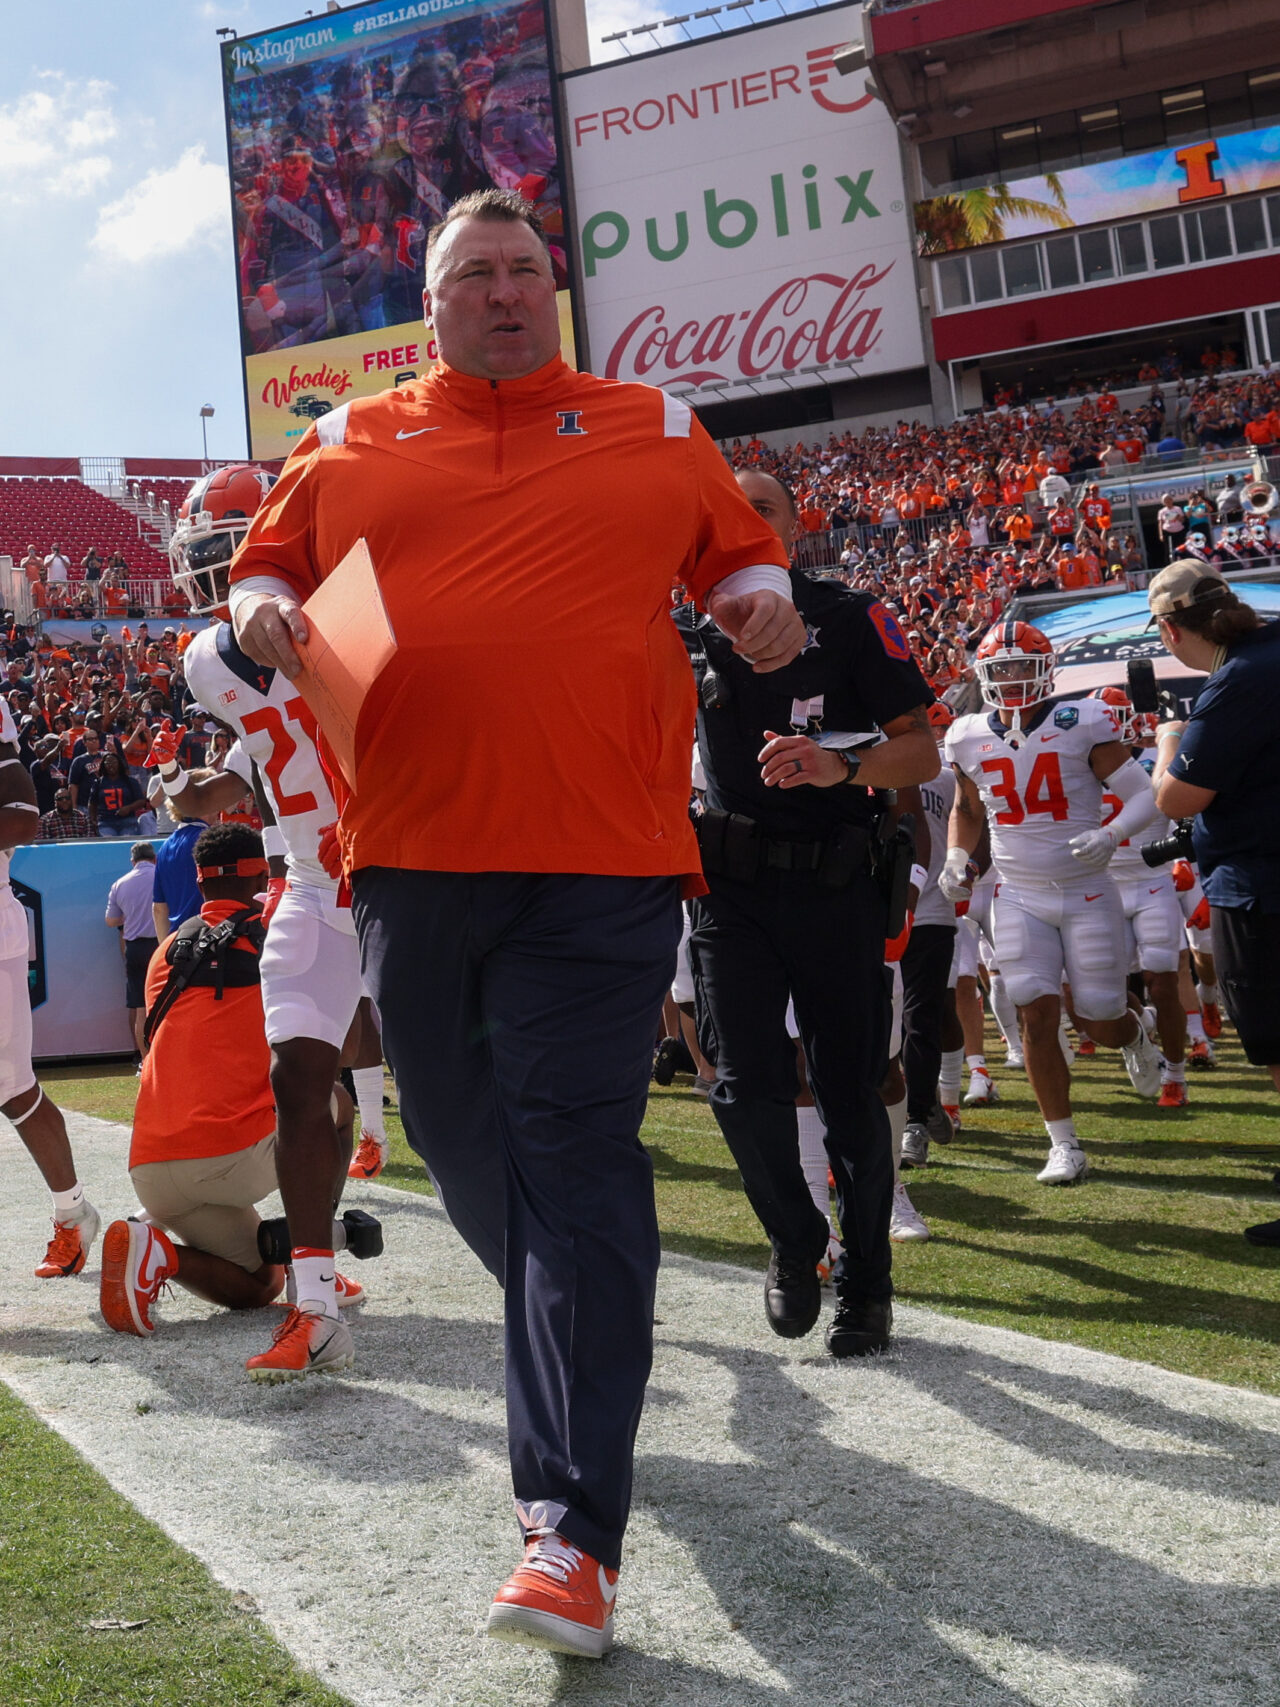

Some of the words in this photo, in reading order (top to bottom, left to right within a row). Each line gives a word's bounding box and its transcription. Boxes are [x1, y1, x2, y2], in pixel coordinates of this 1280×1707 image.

[352, 0, 473, 34] #RELIAQUE
[231, 27, 337, 70] Instagram
[573, 64, 802, 148] FRONTIER
[581, 163, 882, 279] Publix
[604, 258, 898, 378] Coca-Cola
[261, 363, 353, 409] Woodie's
[362, 344, 420, 373] FREE
[979, 751, 1069, 826] 34
